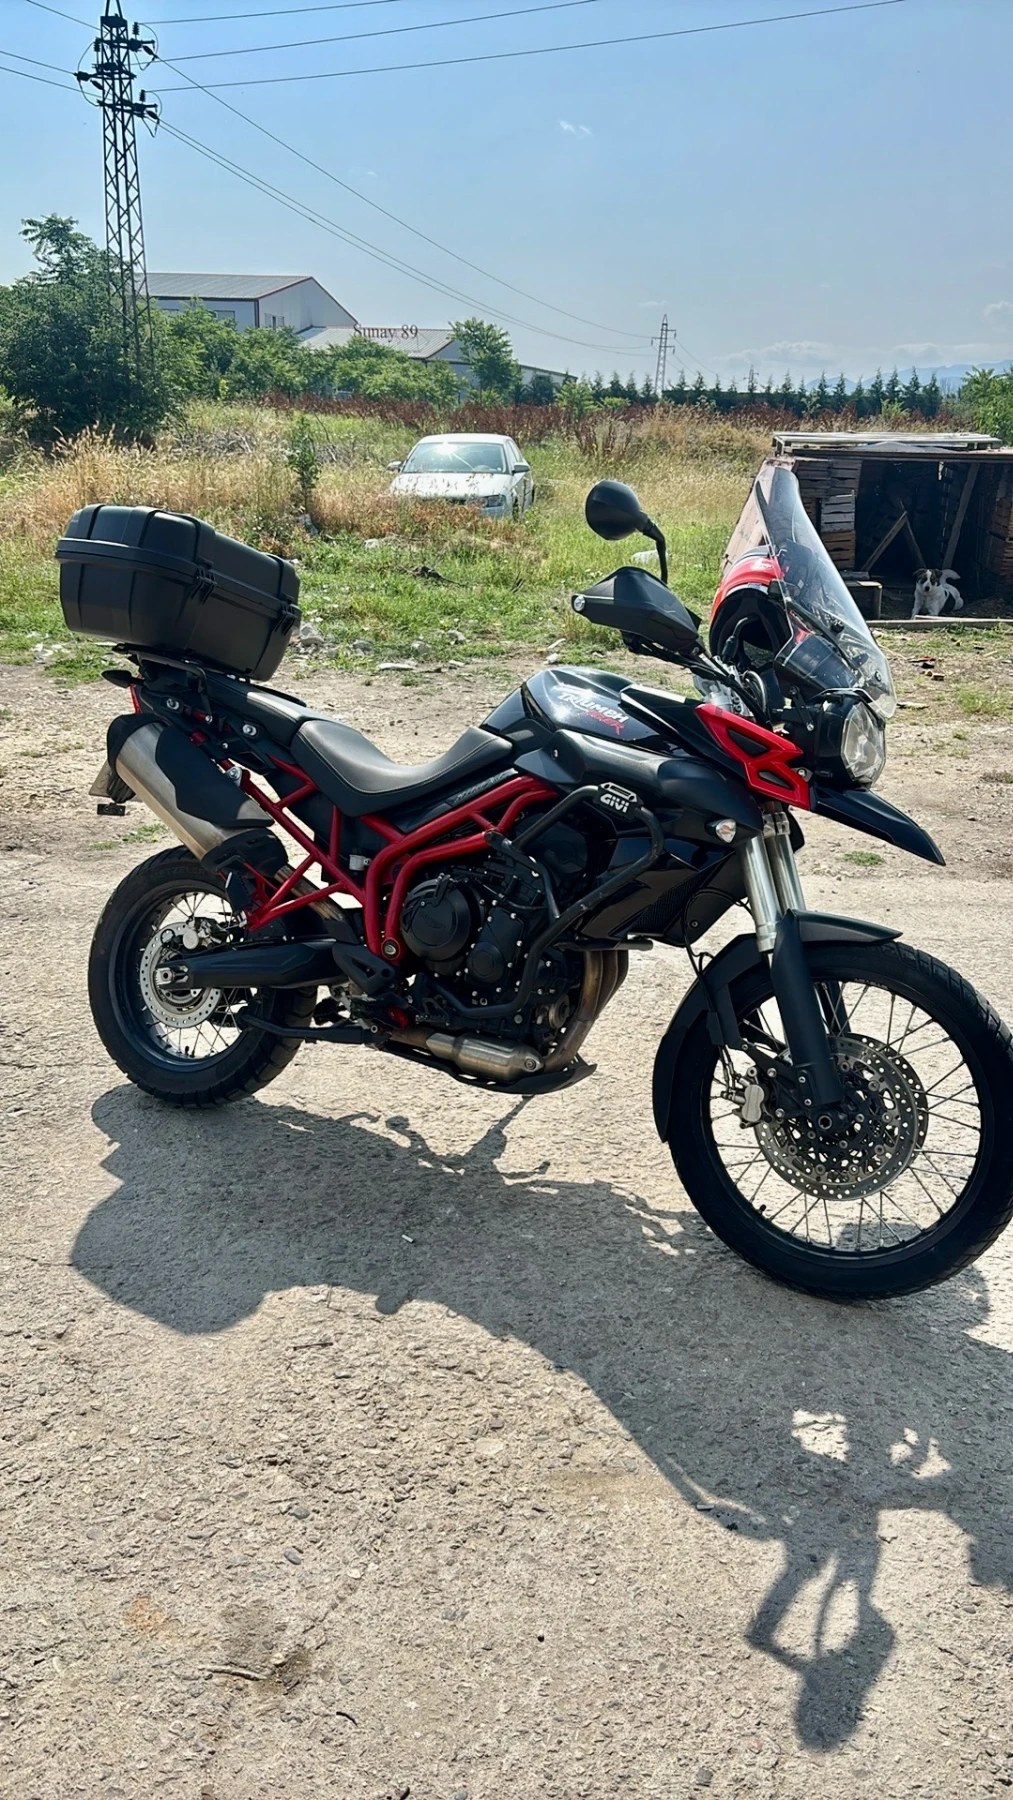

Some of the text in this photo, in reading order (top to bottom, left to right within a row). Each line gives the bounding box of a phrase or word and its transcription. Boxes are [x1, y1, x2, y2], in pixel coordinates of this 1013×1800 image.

[353, 323, 419, 343] Sunay 89
[557, 692, 630, 723] TRIUMPH
[600, 793, 630, 813] GIVI
